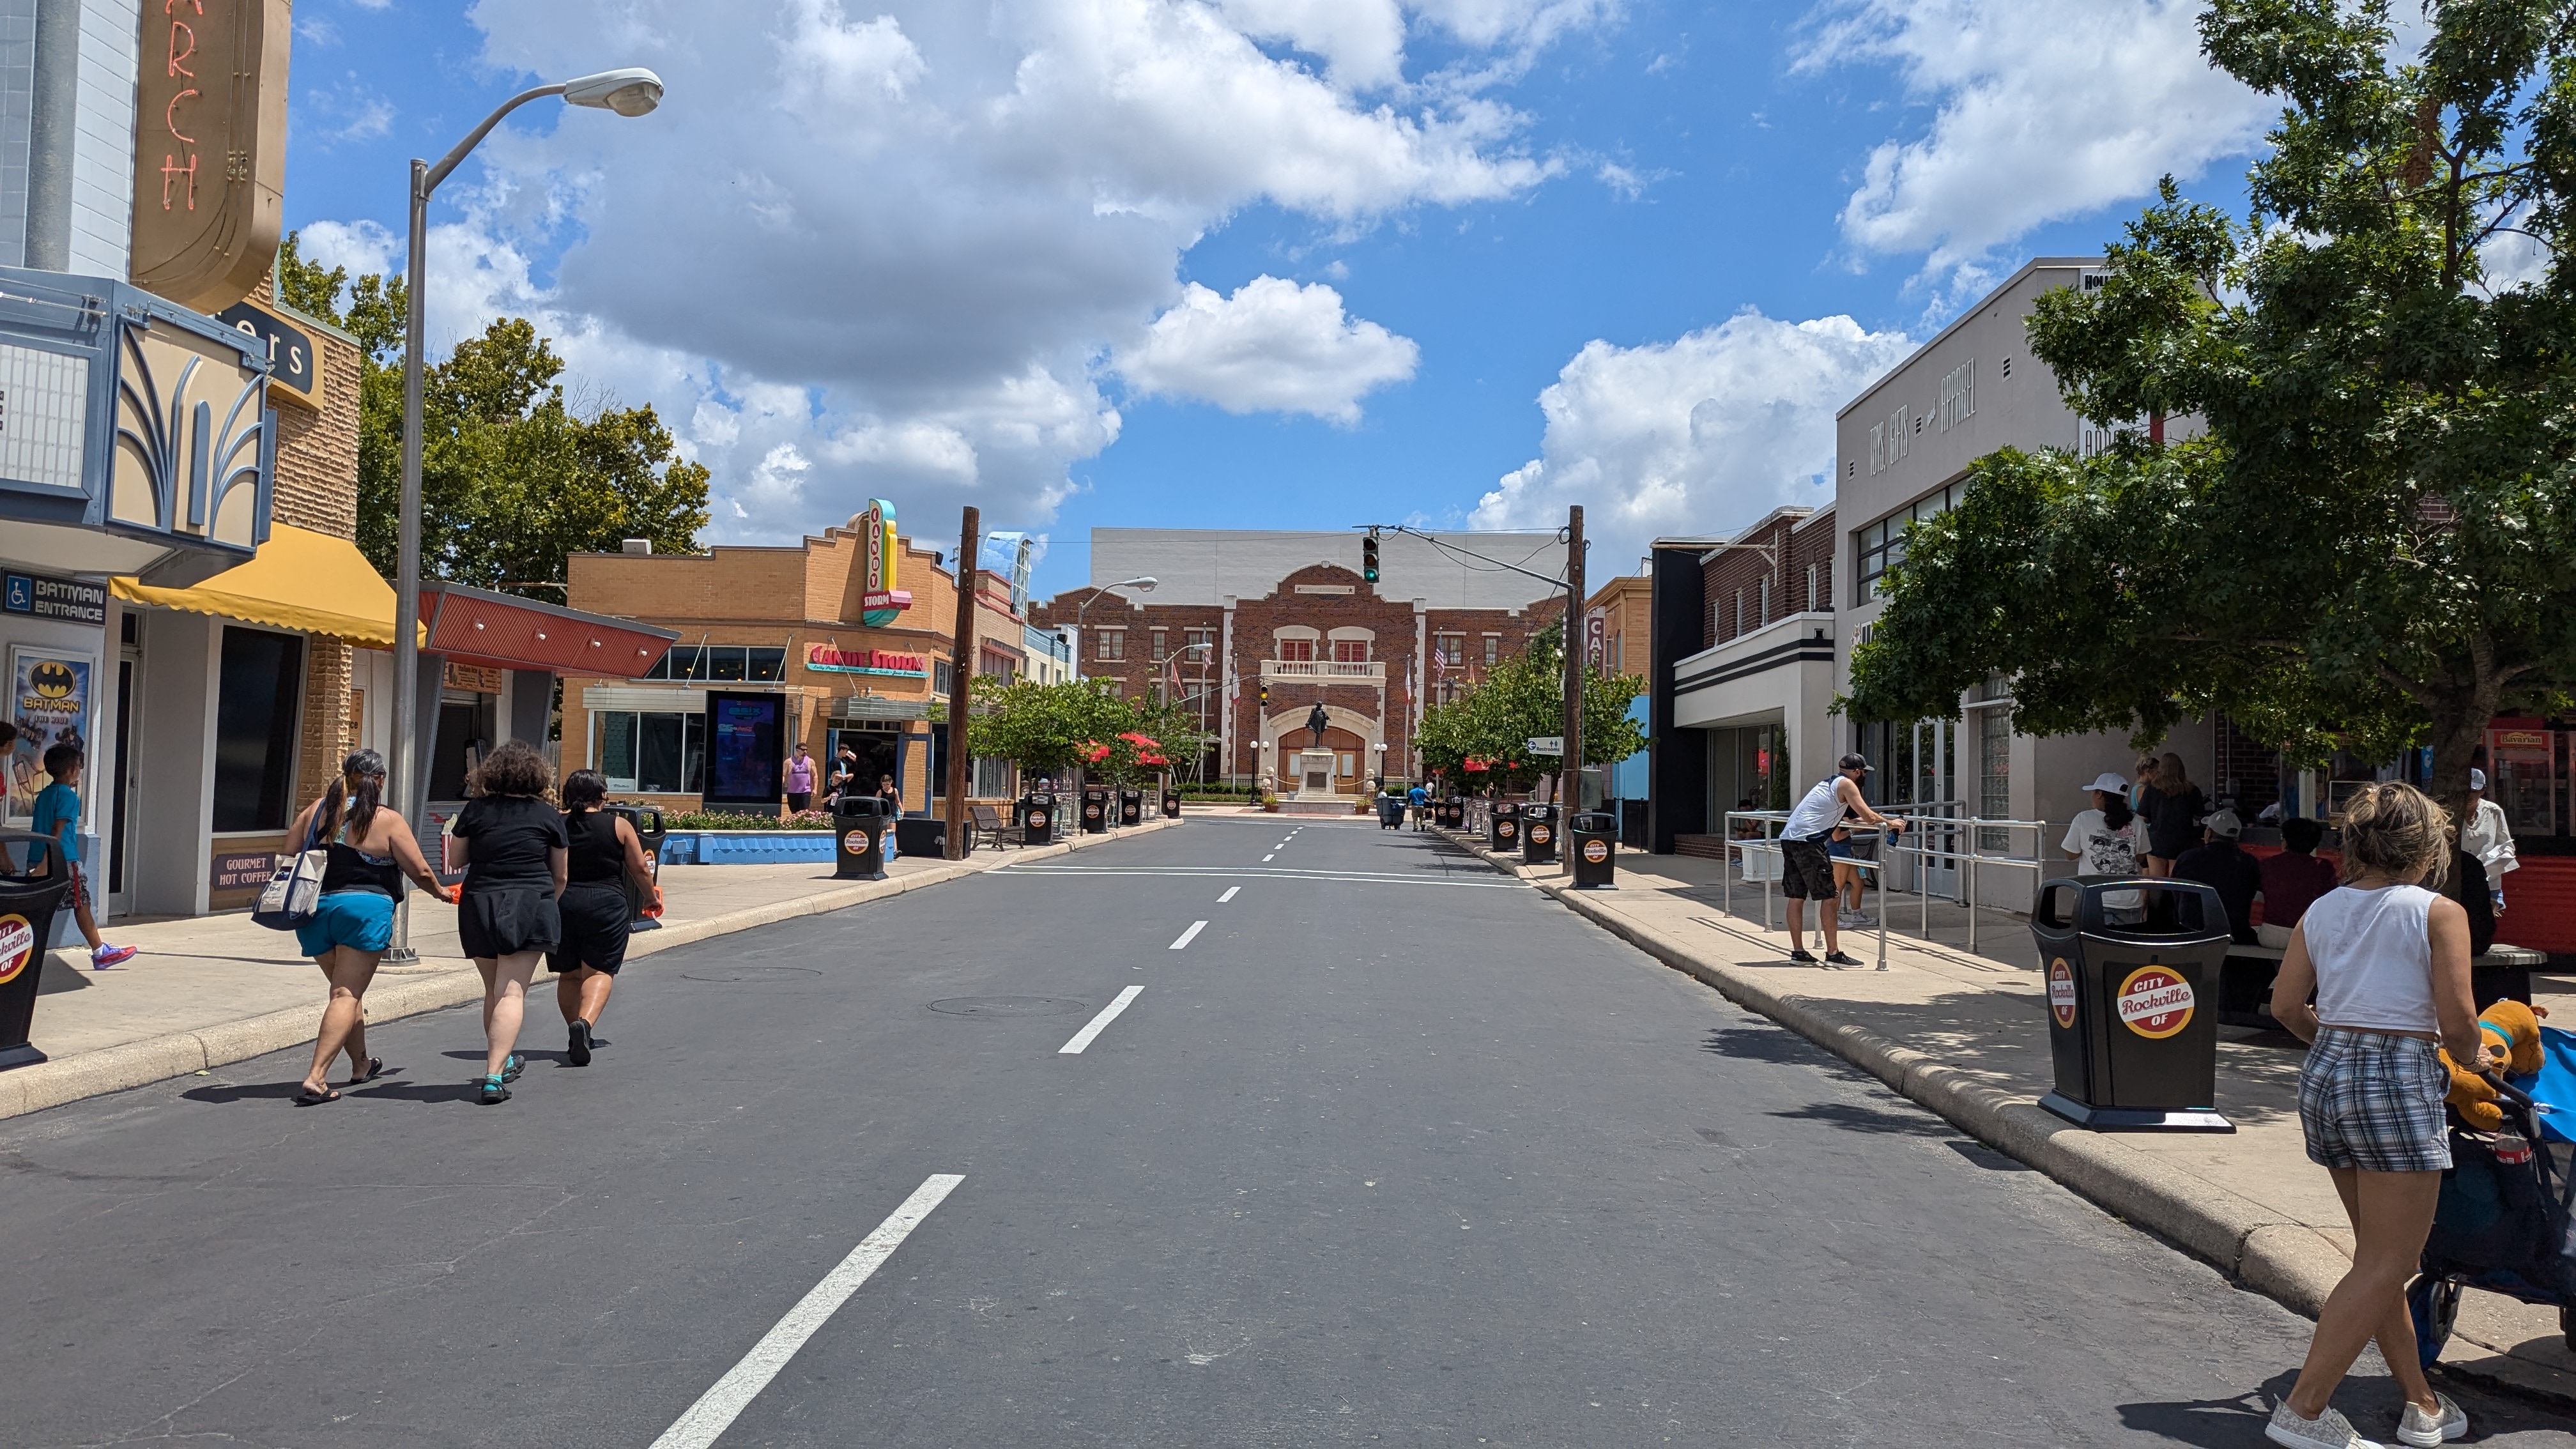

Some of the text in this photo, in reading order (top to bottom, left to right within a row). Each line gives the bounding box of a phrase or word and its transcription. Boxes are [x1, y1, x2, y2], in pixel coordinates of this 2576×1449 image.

[160, 0, 203, 210] RCH
[2085, 275, 2113, 290] HOLL
[217, 311, 302, 374] ers
[1870, 357, 1976, 476] TOYS, GIFTS and APPAREL
[871, 510, 879, 586] CANDY
[35, 580, 103, 604] BATMAN
[864, 594, 889, 607] STORM
[35, 600, 103, 620] ENTRANCE
[1589, 621, 1602, 665] CAF
[810, 645, 926, 671] CANDY STORM
[24, 697, 80, 712] BATMAN
[34, 715, 49, 723] THE
[349, 721, 358, 730] ce
[2502, 735, 2541, 744] Bavarian
[227, 858, 266, 870] GOURMET
[219, 874, 237, 885] HOT
[0, 923, 14, 939] TY
[0, 931, 32, 956] kville
[1, 957, 14, 972] OF
[2055, 970, 2066, 980] CITY
[2051, 984, 2074, 1000] Rockville
[2134, 976, 2165, 993] CITY
[2122, 988, 2191, 1016] Rockville
[2061, 1006, 2068, 1015] OF
[2151, 1014, 2168, 1026] OF
